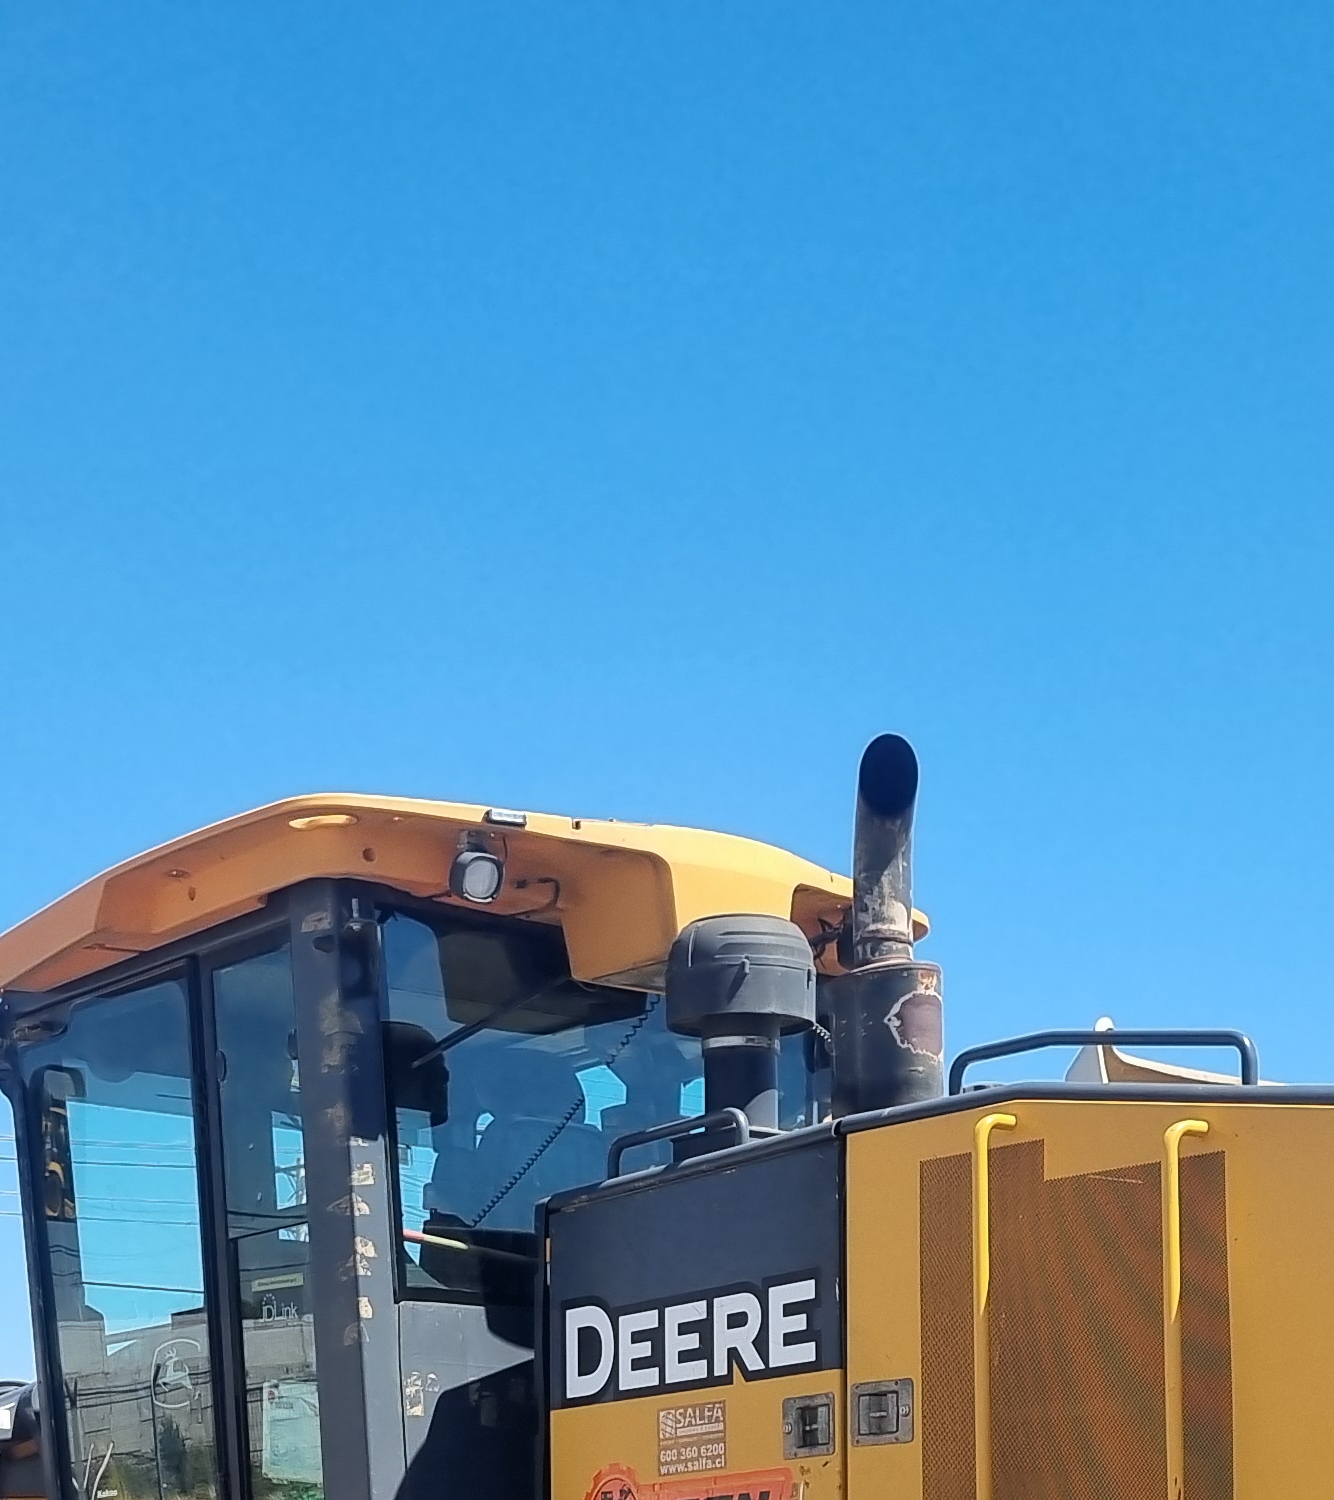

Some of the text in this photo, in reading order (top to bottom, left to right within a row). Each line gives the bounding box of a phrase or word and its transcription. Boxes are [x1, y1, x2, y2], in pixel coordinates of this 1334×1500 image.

[565, 1278, 817, 1399] DEERE
[675, 1403, 725, 1428] SALFA
[660, 1443, 725, 1462] 600 360 6200
[659, 1455, 725, 1475] www.salfa.cl
